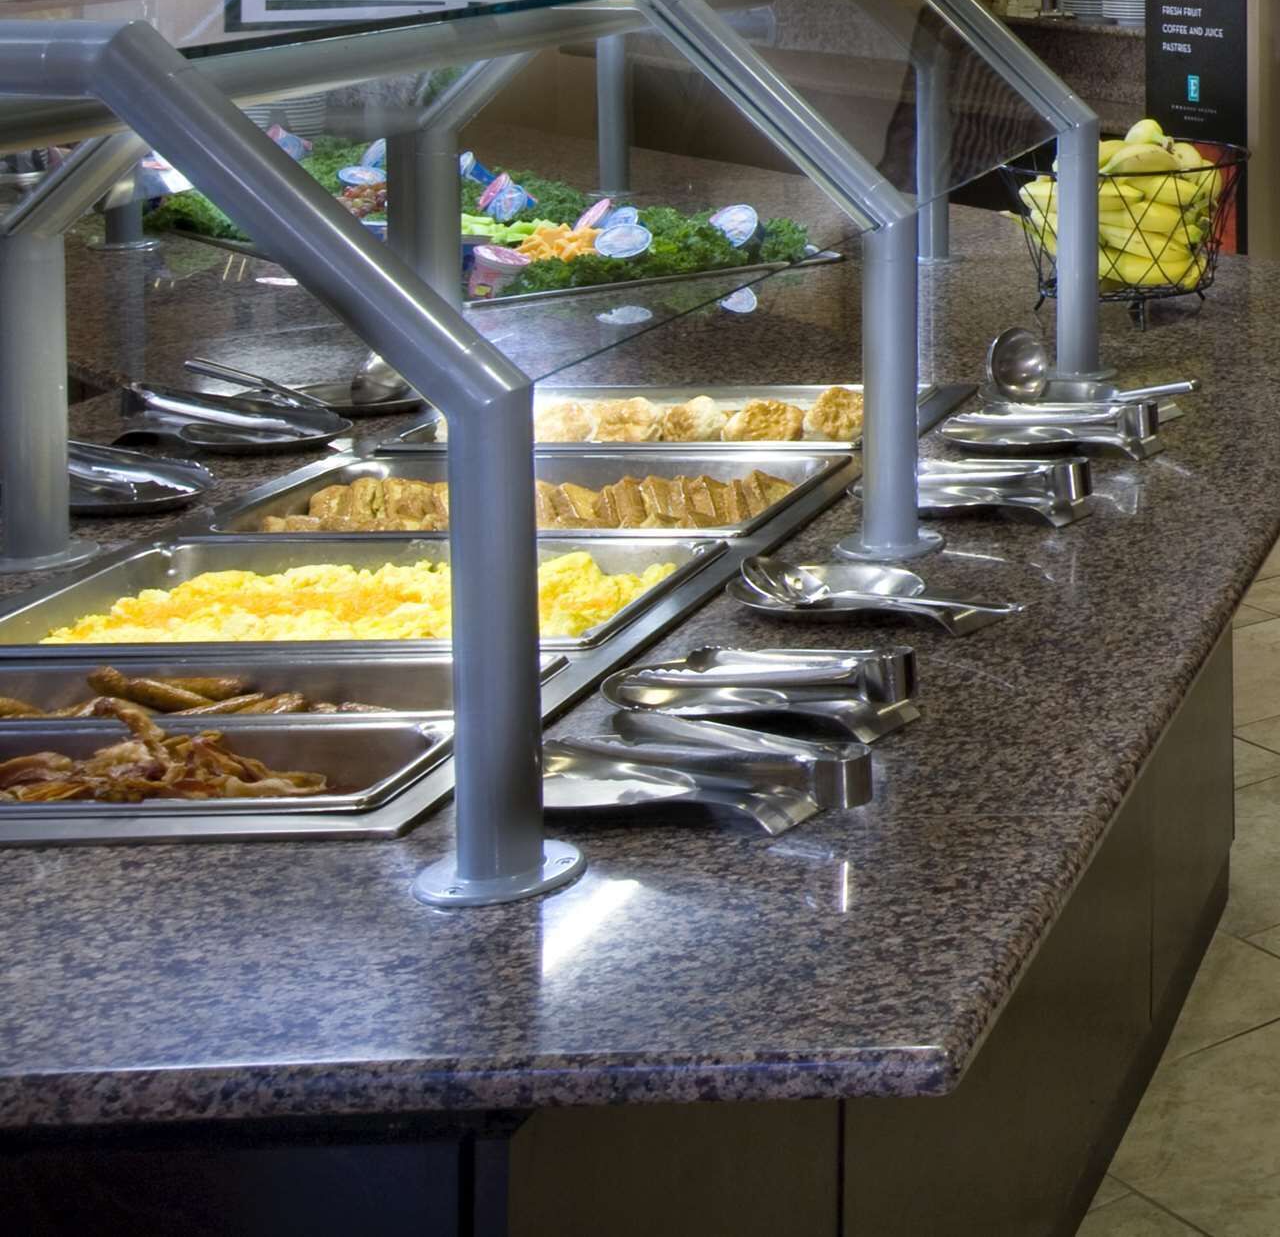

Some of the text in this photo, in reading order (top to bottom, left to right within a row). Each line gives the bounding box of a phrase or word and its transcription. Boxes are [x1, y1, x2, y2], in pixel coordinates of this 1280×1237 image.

[1161, 5, 1202, 18] FRESH FRUIT
[1161, 23, 1224, 39] COFFEE AND JUICE
[1162, 42, 1192, 54] PASTRIES
